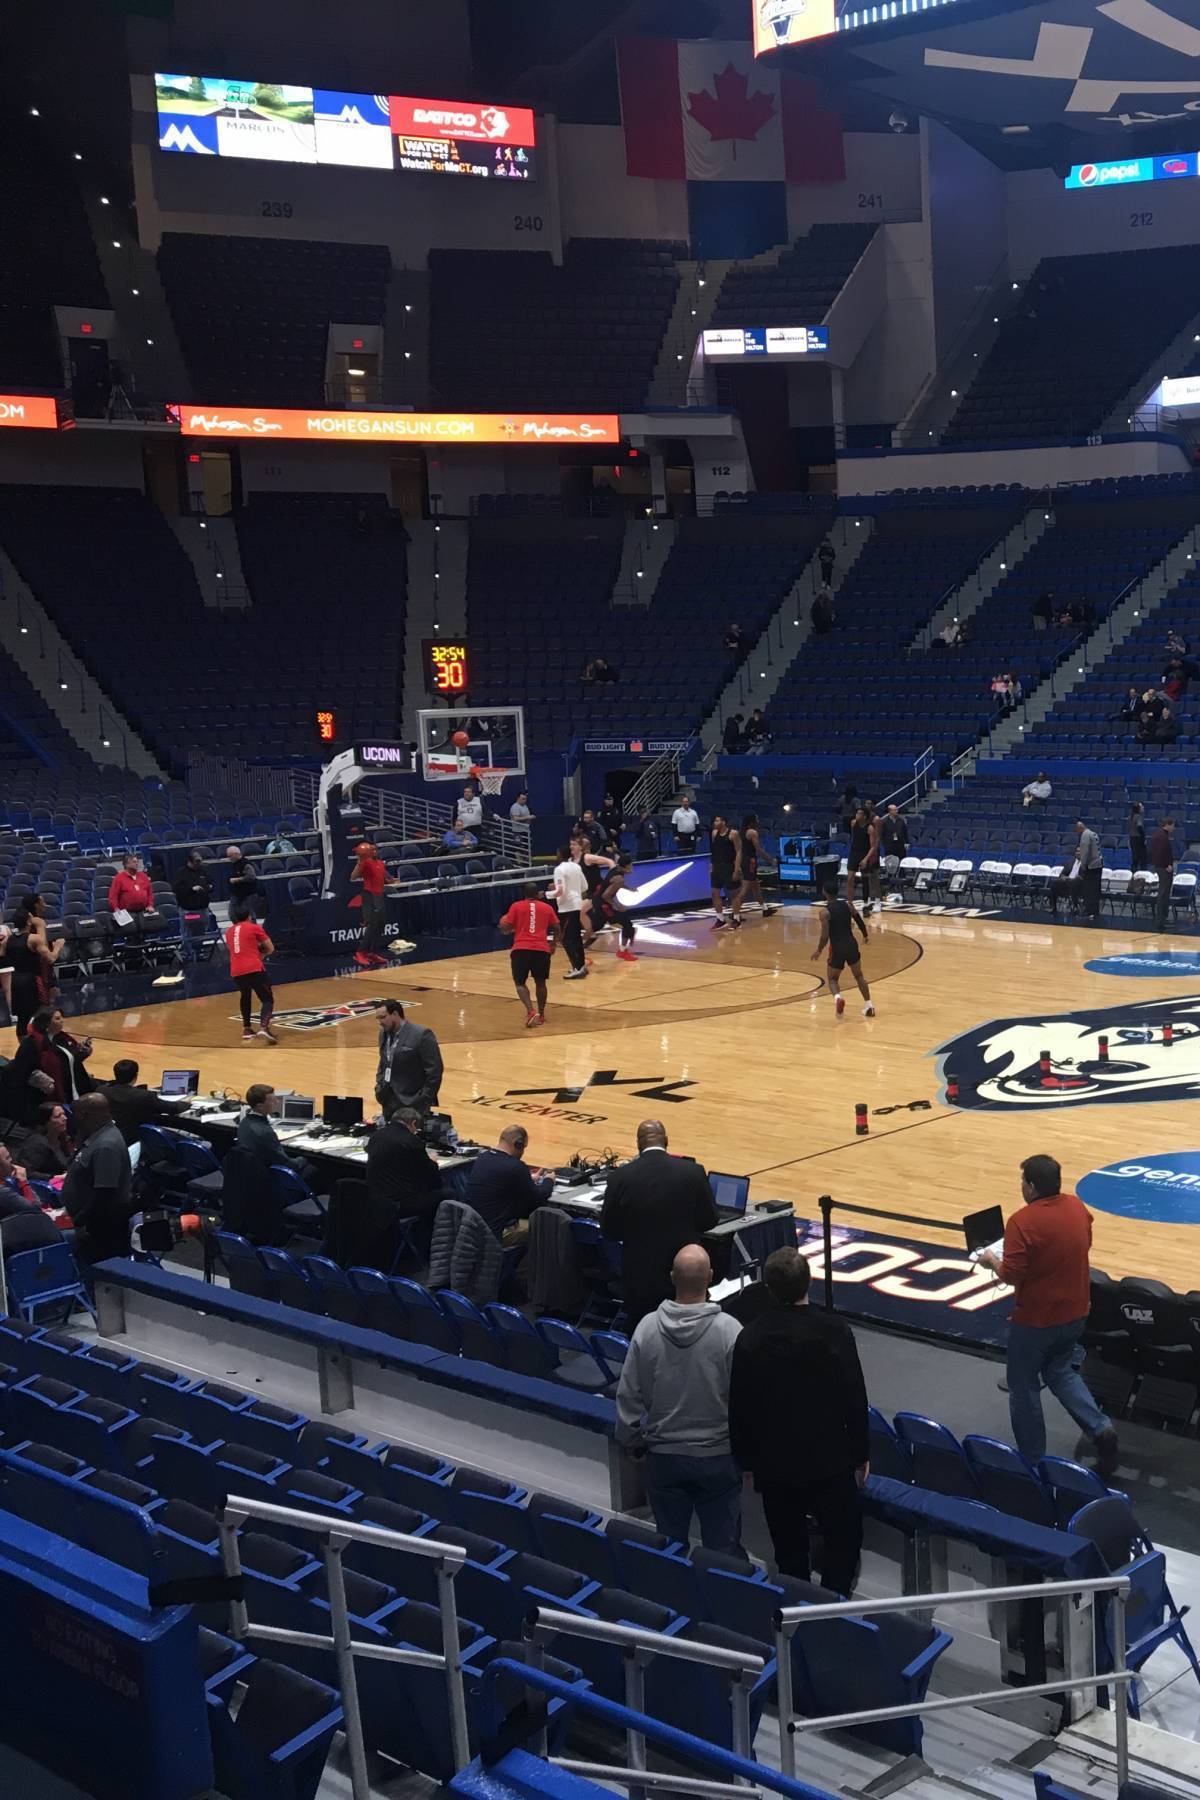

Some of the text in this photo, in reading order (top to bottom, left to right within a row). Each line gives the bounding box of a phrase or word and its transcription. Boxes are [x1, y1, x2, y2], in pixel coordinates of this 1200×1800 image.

[413, 109, 477, 127] DATTCO
[1097, 111, 1188, 126] XL
[404, 140, 449, 153] WATCH
[401, 157, 489, 177] WatchForMeCT.org
[1100, 162, 1141, 182] pepsi
[858, 193, 882, 208] 241
[262, 201, 293, 218] 239
[513, 215, 543, 232] 240
[1130, 212, 1153, 227] 212
[307, 417, 475, 435] MOHEGANSUN.COM
[1086, 435, 1102, 446] 113
[711, 466, 731, 476] 112
[432, 646, 465, 662] 32:54
[437, 662, 463, 688] 30
[362, 746, 401, 762] UCONN
[586, 743, 625, 751] BUD LIGHT
[500, 1101, 608, 1125] CENTER
[1124, 1307, 1154, 1322] LAZ
